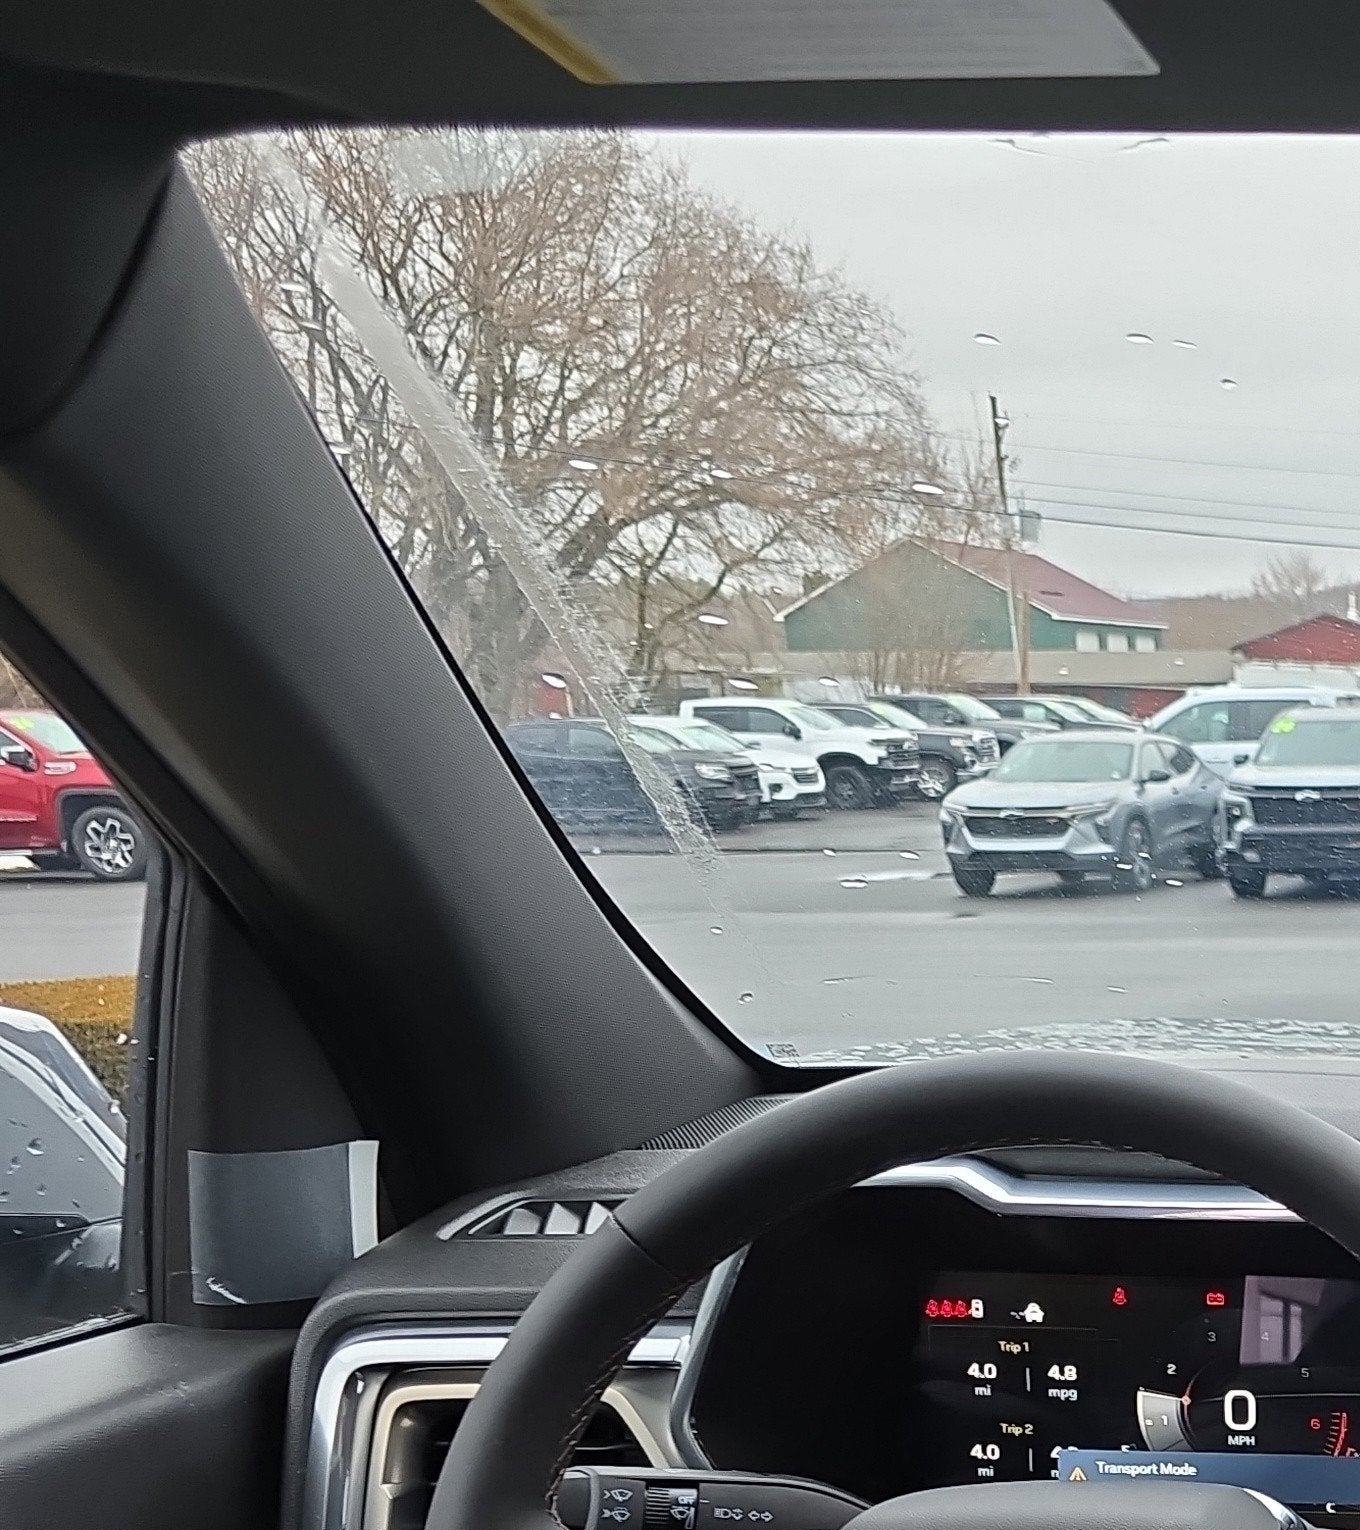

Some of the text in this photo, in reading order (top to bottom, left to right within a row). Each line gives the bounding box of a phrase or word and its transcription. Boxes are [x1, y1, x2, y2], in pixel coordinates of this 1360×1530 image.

[998, 1341, 1021, 1354] Trip
[967, 1363, 997, 1379] 4.0
[1047, 1365, 1077, 1381] 4.8
[975, 1384, 992, 1397] mi
[1048, 1387, 1078, 1400] mpg
[1223, 1390, 1257, 1431] 0
[1000, 1423, 1034, 1436] Trip 2
[1227, 1434, 1256, 1448] MPH
[970, 1444, 1000, 1460] 4.0
[977, 1465, 994, 1478] mi
[1096, 1460, 1197, 1479] Transport Mode
